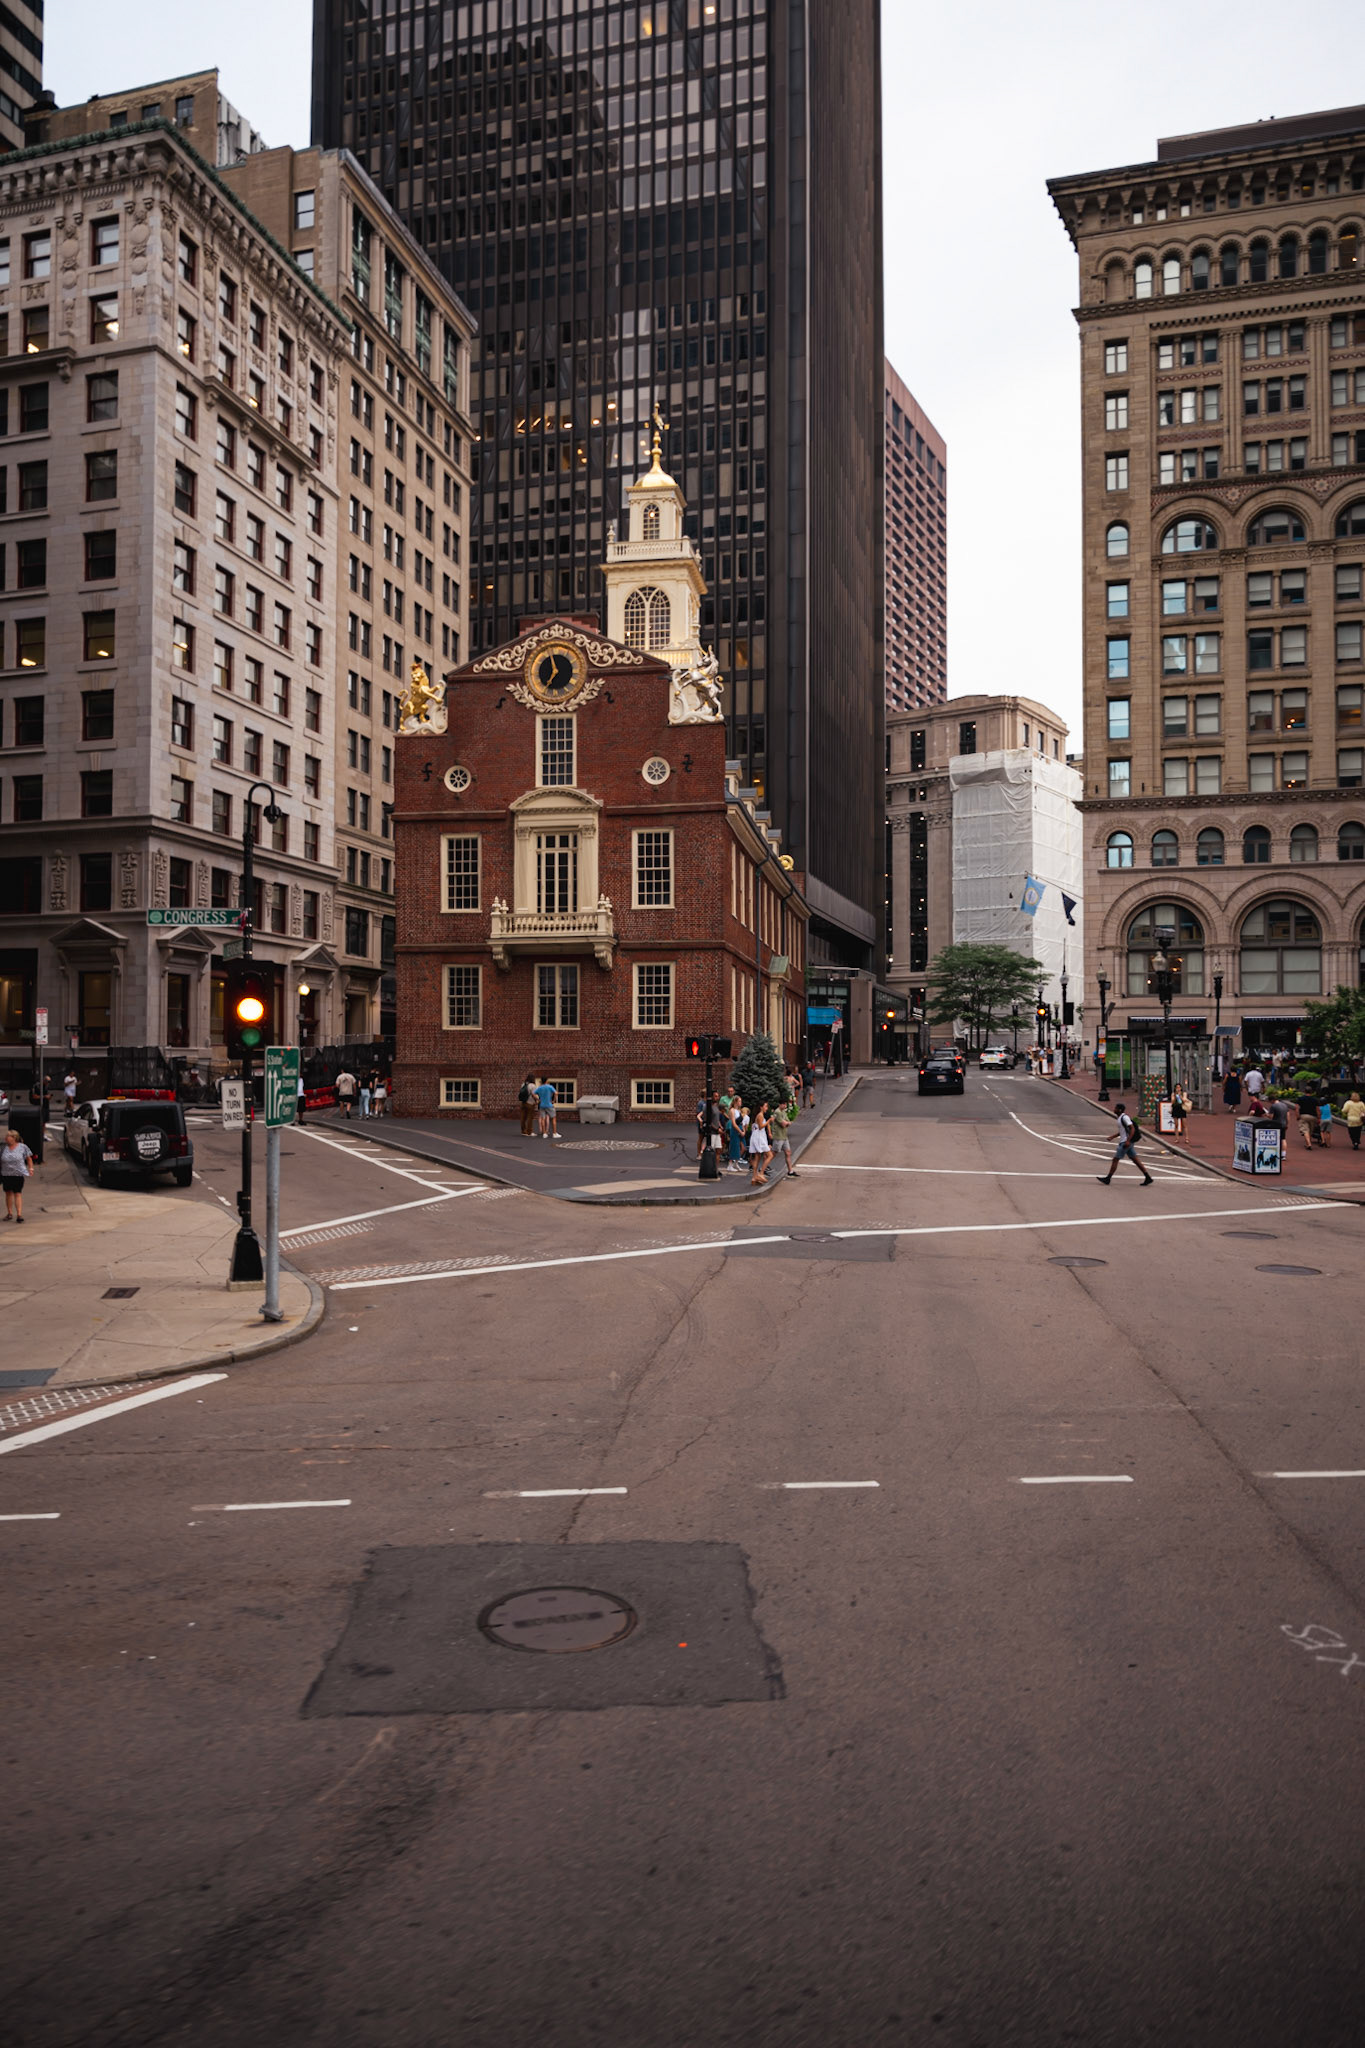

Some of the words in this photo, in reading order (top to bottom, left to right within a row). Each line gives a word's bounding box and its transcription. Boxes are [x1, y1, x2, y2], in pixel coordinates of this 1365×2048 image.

[164, 910, 227, 924] CONGRESS
[229, 1088, 237, 1097] NO
[226, 1101, 240, 1109] TURN
[224, 1113, 232, 1121] ON
[232, 1112, 243, 1121] RED
